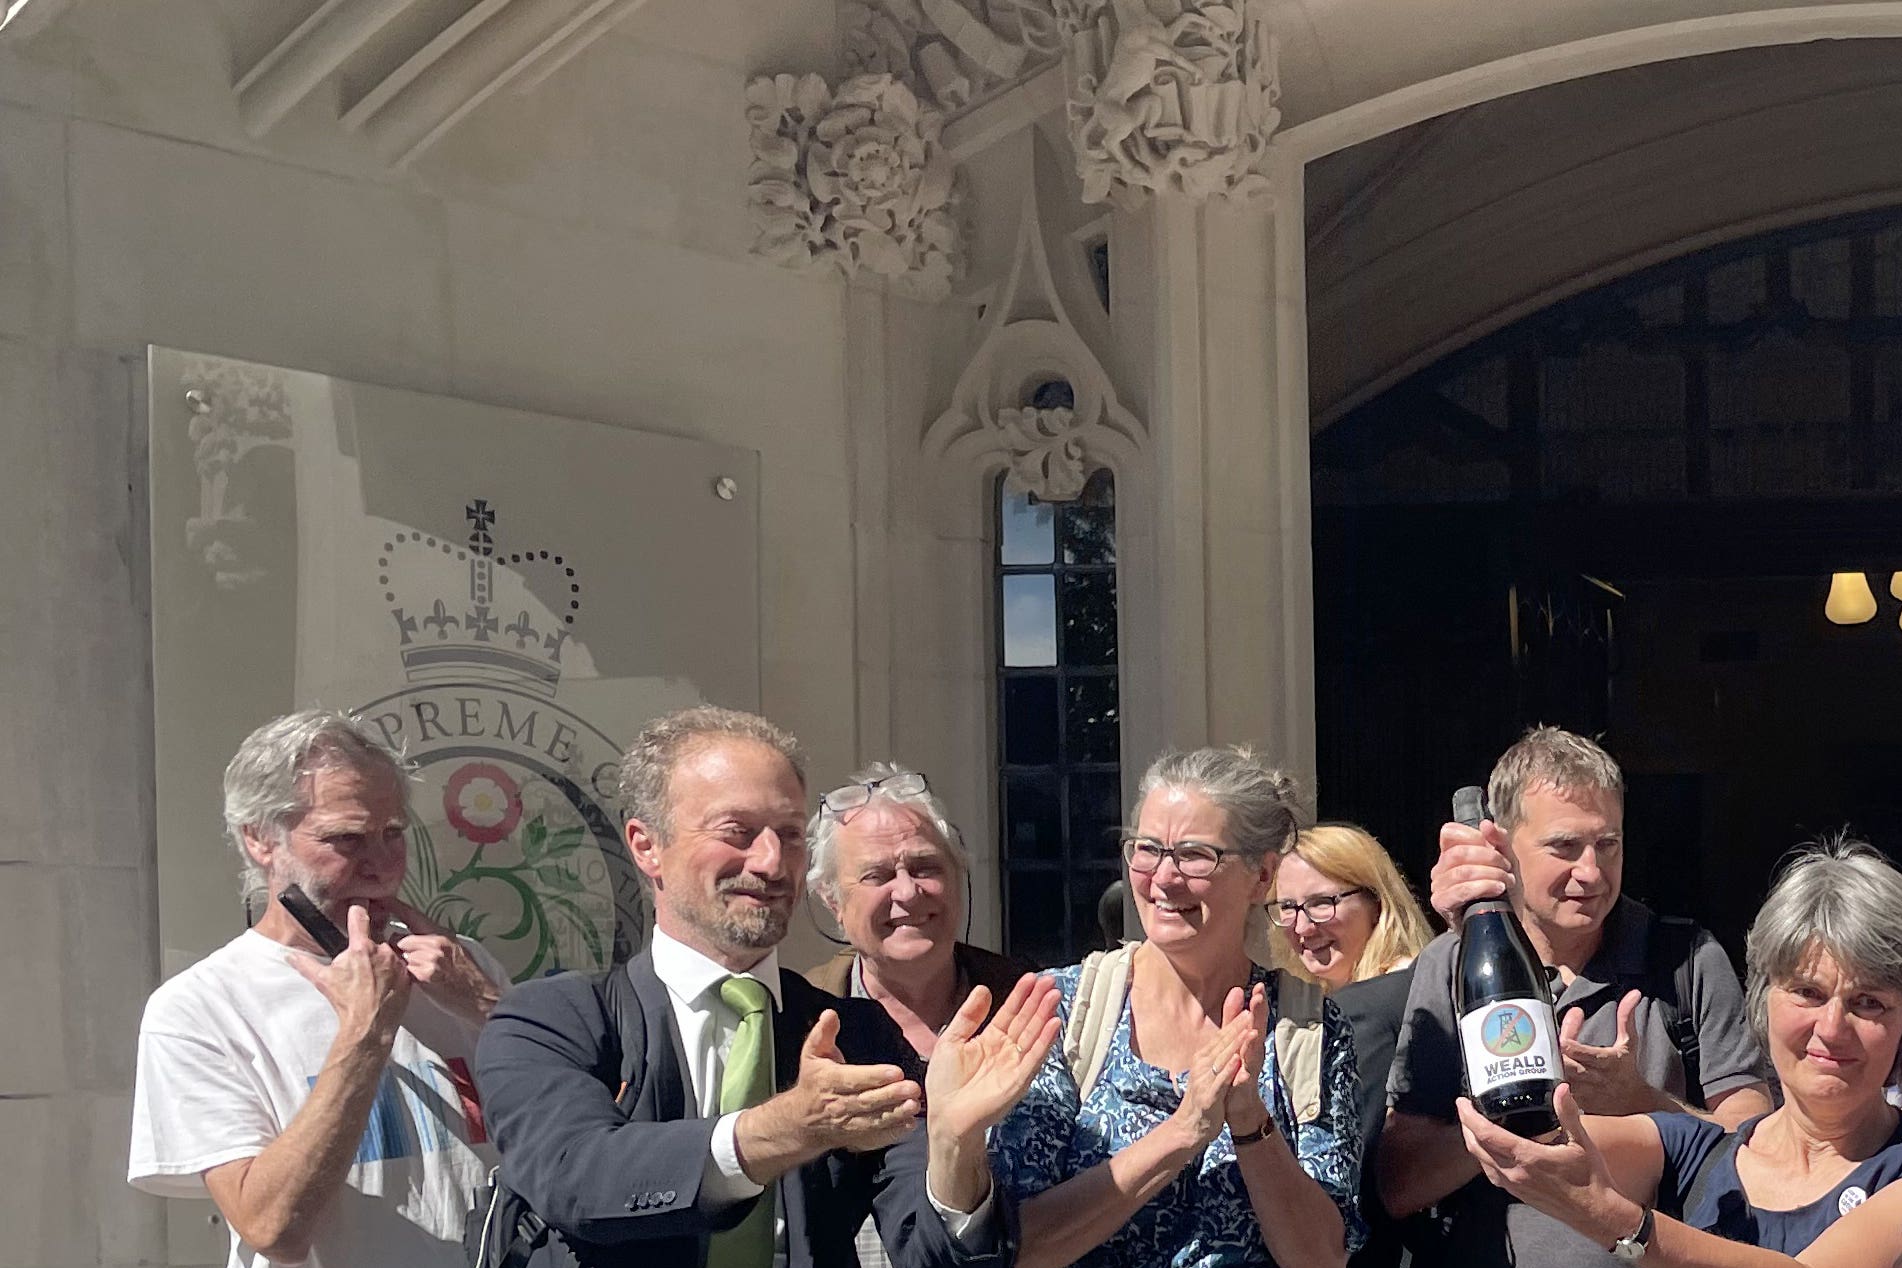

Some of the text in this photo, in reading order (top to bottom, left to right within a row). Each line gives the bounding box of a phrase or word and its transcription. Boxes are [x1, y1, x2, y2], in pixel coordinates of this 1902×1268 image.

[372, 698, 577, 763] PREME
[1484, 1055, 1546, 1077] WEALD
[1487, 1067, 1547, 1084] ACTION GROUP
